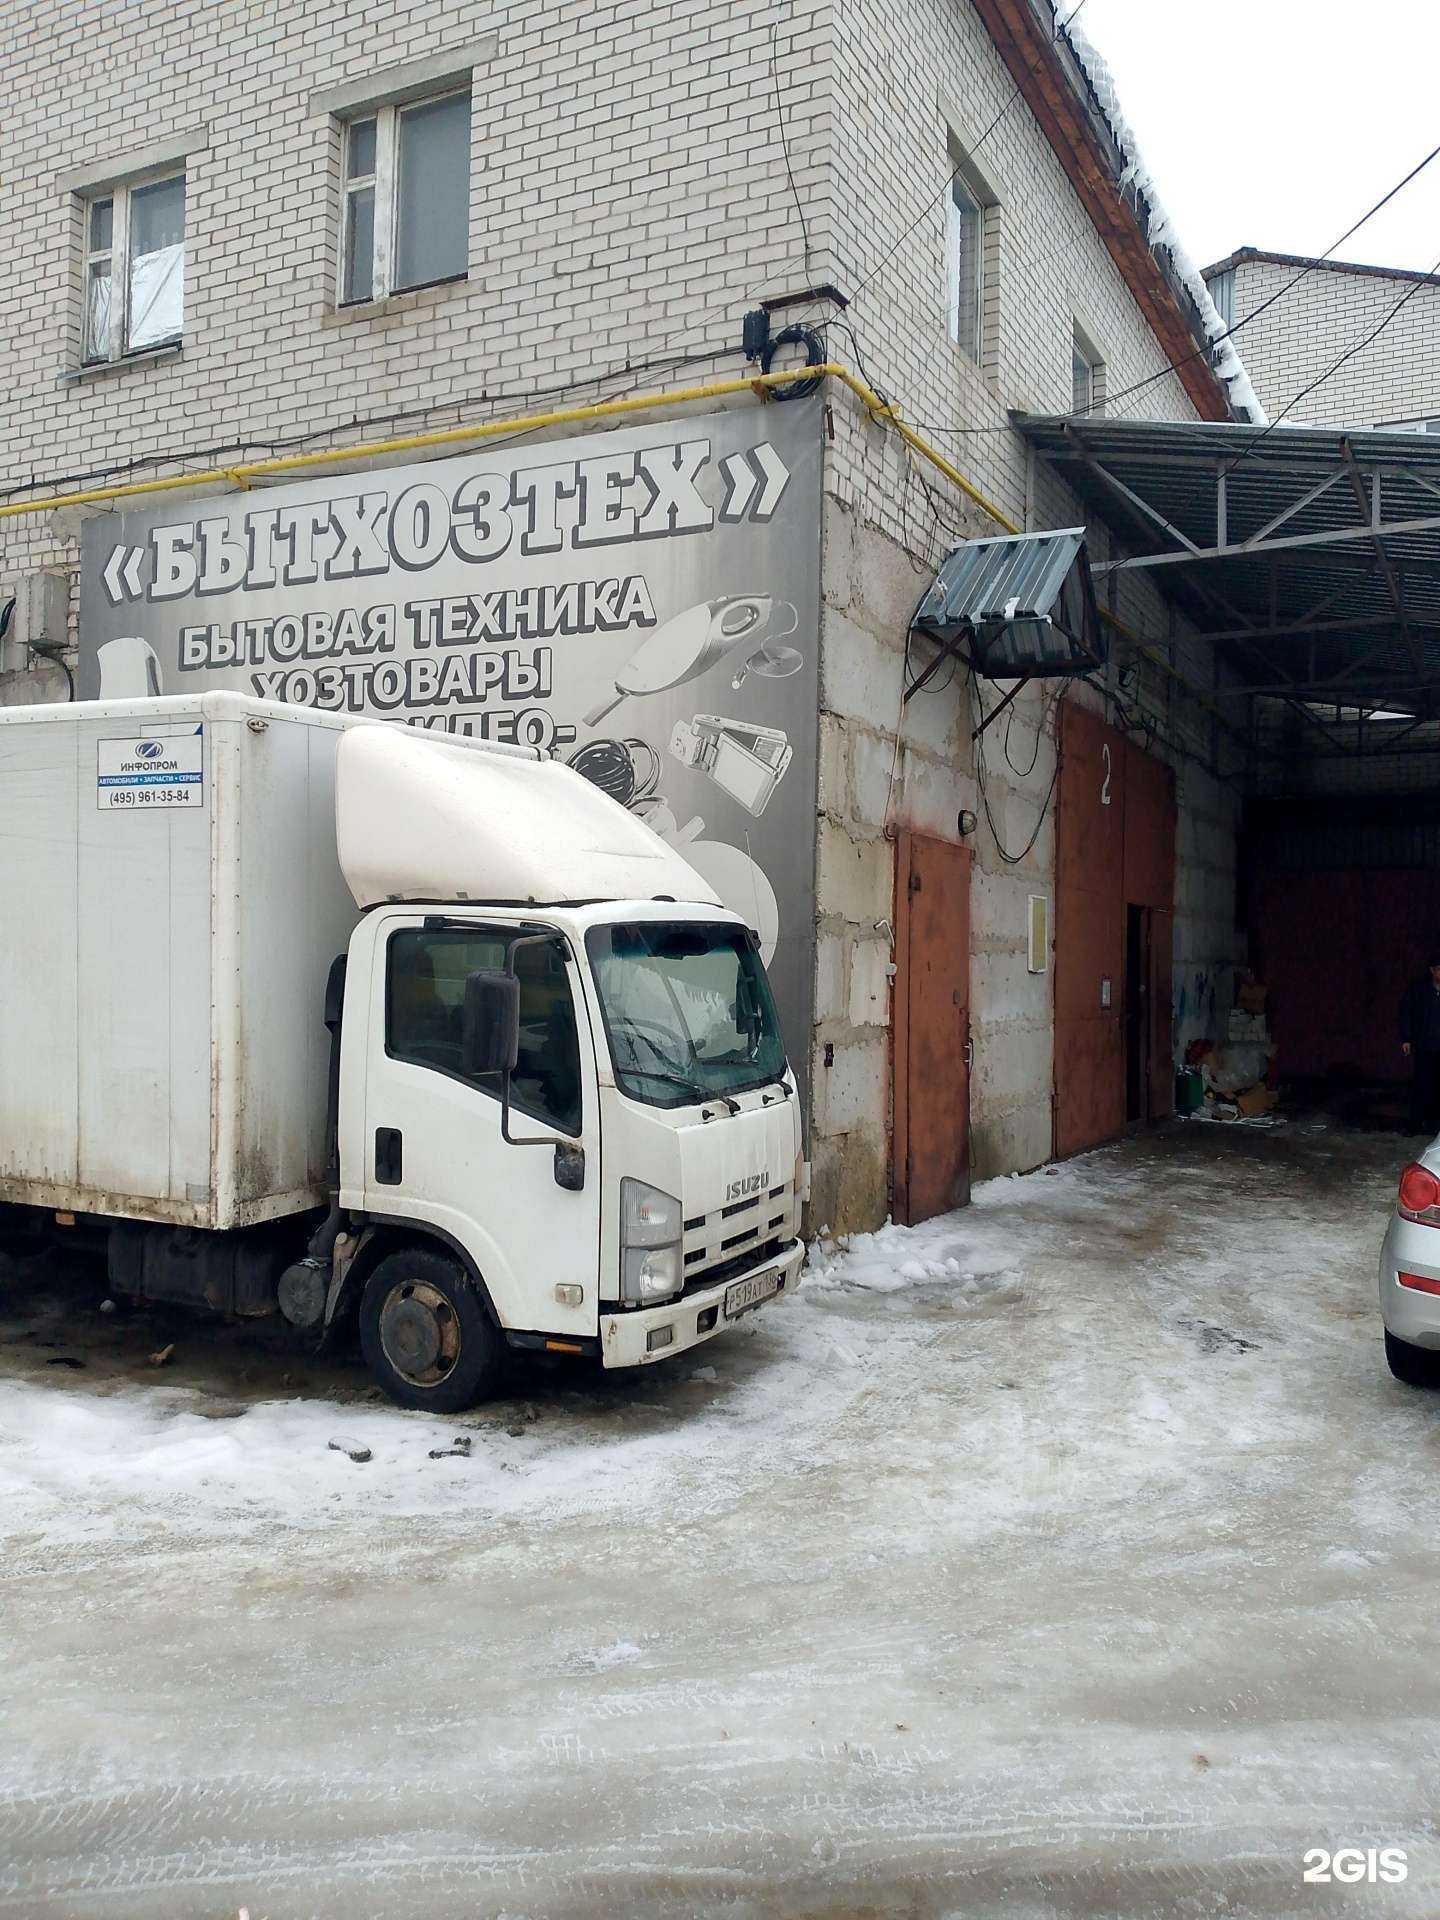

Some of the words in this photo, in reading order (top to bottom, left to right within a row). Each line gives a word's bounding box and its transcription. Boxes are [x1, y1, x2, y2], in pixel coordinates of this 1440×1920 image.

[103, 438, 792, 605] «БЫТХОЗТЕХ»
[178, 603, 396, 672] БЫТОВАЯ
[405, 575, 657, 649] ТЕХНИКА
[251, 648, 552, 712] ХОЗТОВАРЫ
[120, 760, 178, 772] ИНФОПРОМ
[143, 775, 174, 784] ЗАПЧАСТИ
[109, 791, 136, 806] (495)
[138, 789, 190, 803] 961-35-84
[726, 1171, 769, 1201] ISUZU
